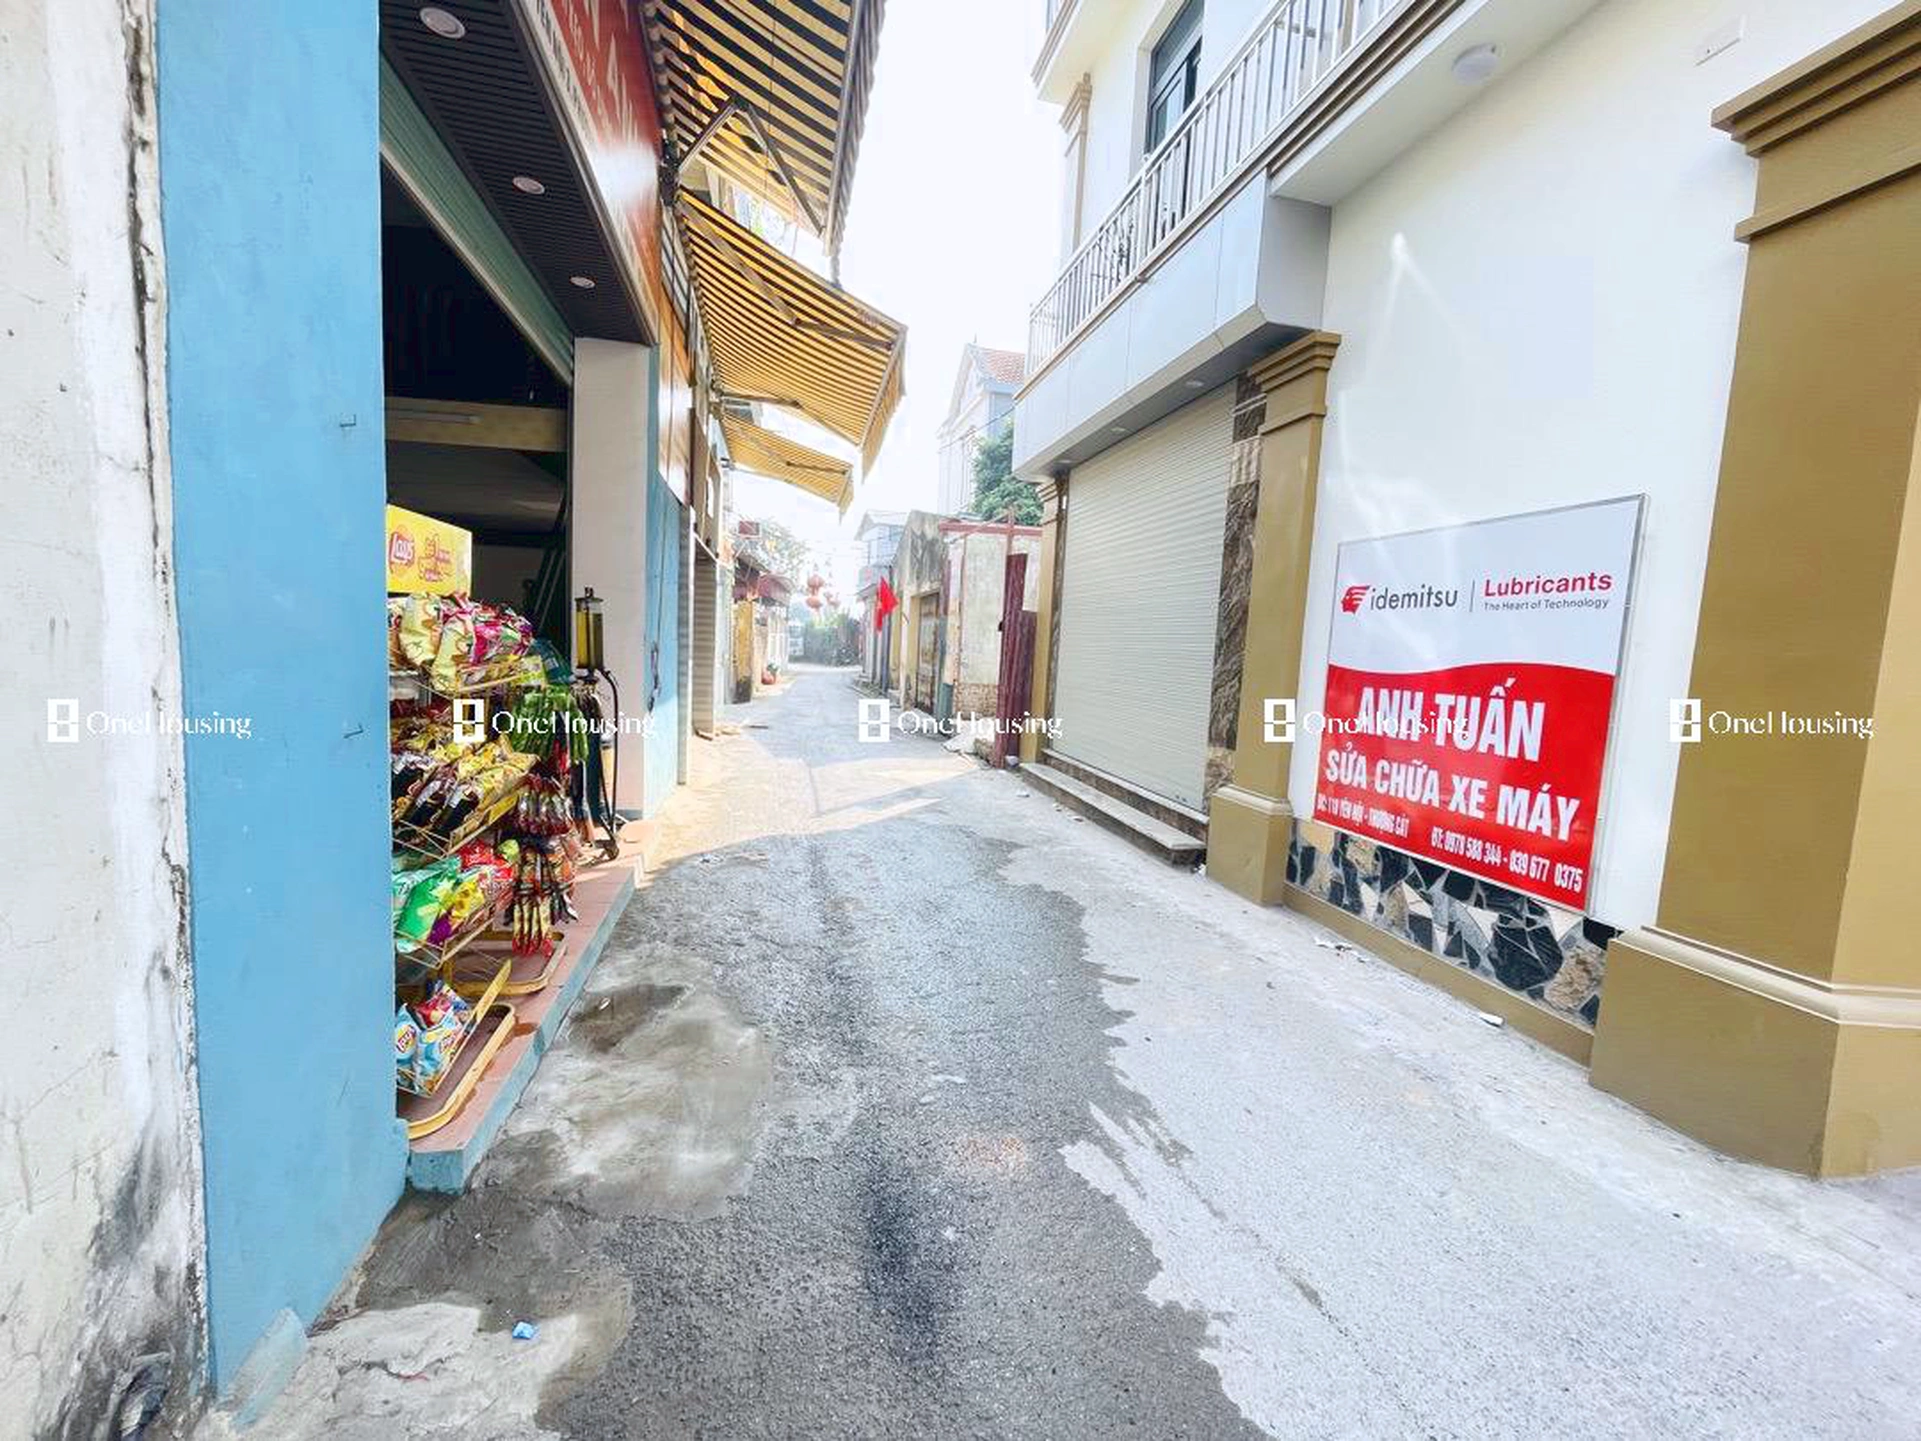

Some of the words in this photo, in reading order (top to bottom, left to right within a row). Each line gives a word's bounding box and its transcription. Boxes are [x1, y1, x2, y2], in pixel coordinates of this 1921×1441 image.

[1370, 583, 1459, 611] idemitsu
[1483, 571, 1613, 598] Lubricants
[1502, 600, 1530, 612] Heart
[1532, 599, 1542, 611] of
[1544, 597, 1610, 611] Technology
[1357, 686, 1424, 742] ANH
[1434, 677, 1545, 762] TUẤN
[1326, 741, 1367, 790] SỬA
[1374, 758, 1440, 808] CHỮA
[1448, 774, 1487, 819] XE
[1496, 783, 1580, 842] MÁY
